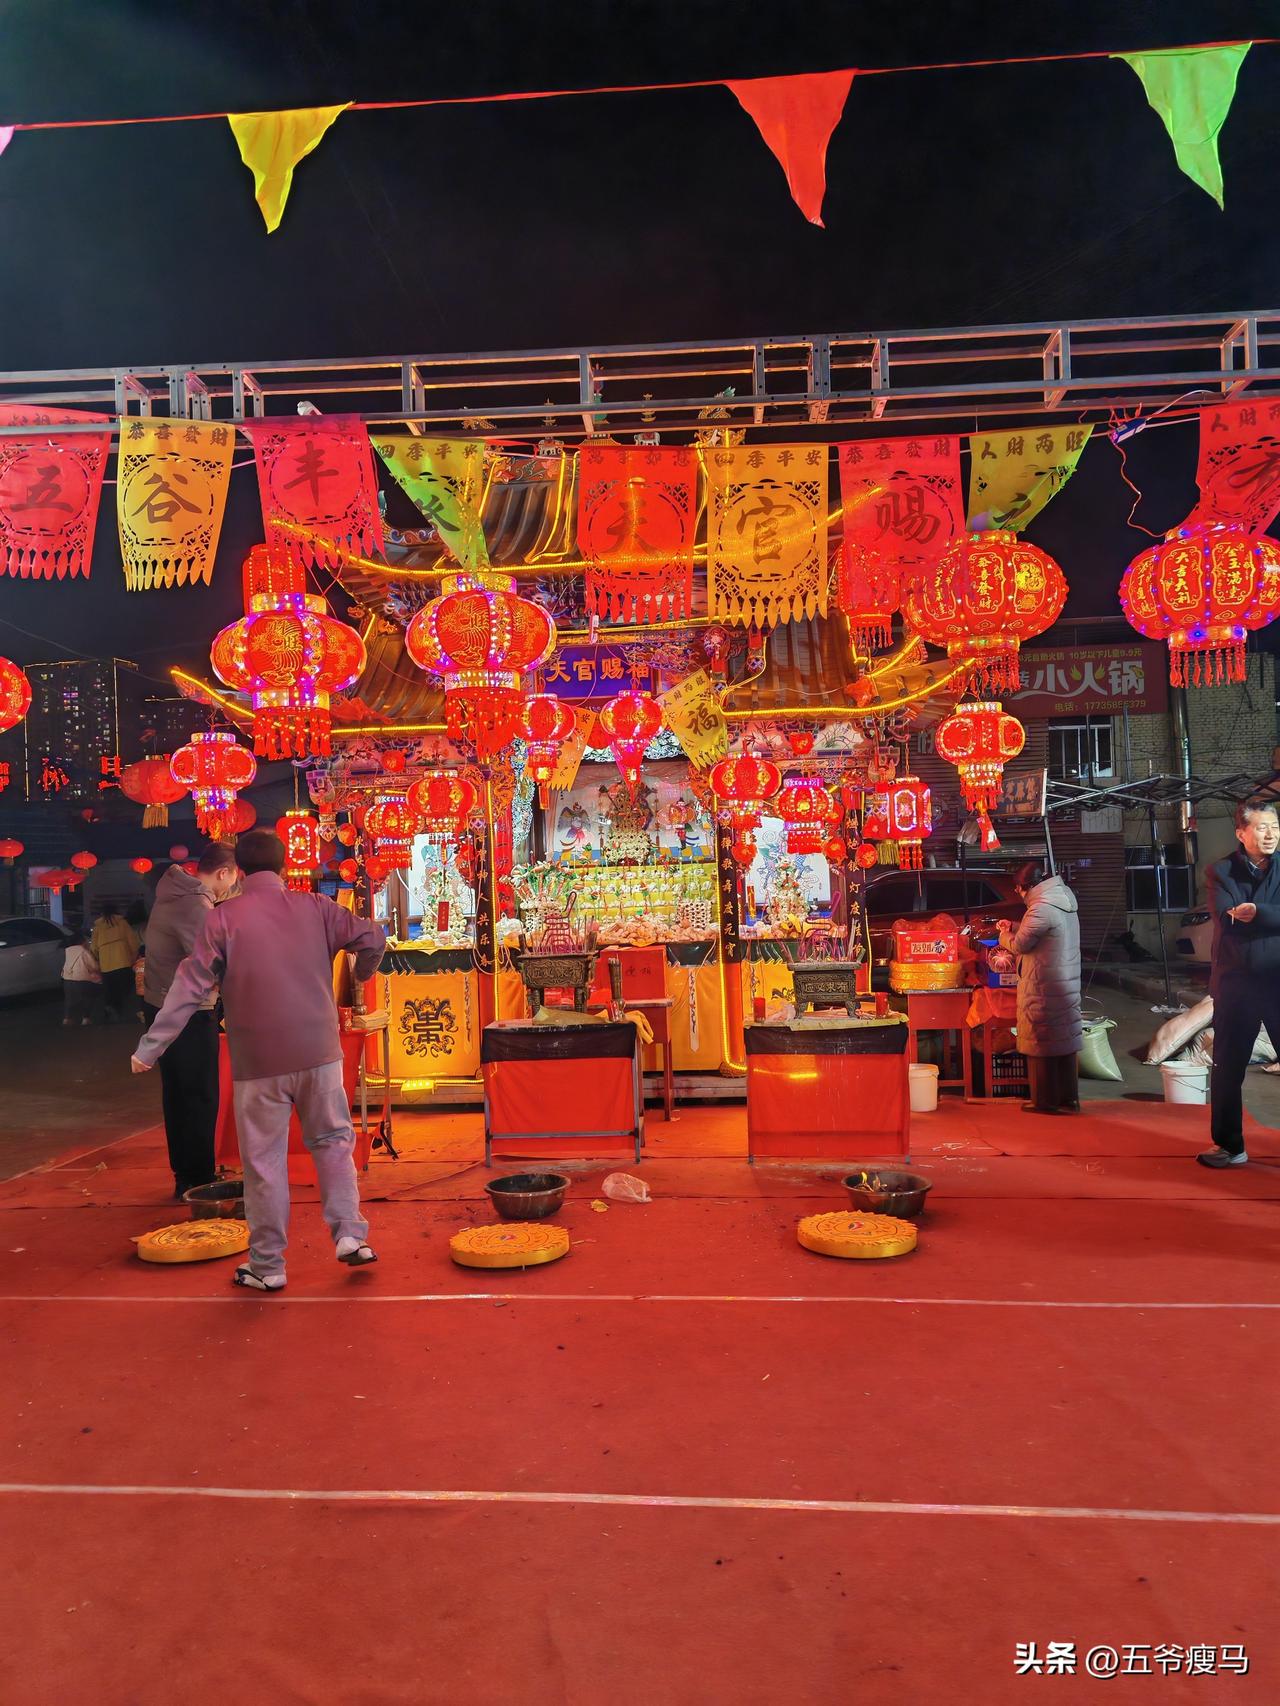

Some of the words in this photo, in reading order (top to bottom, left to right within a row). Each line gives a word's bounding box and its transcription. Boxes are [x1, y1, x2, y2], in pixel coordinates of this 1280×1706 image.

[9, 465, 74, 513] 五
[131, 472, 202, 522] 谷
[284, 441, 339, 506] 丰
[736, 496, 797, 565] 官
[546, 657, 650, 682] 天官赐福
[686, 702, 719, 737] 福
